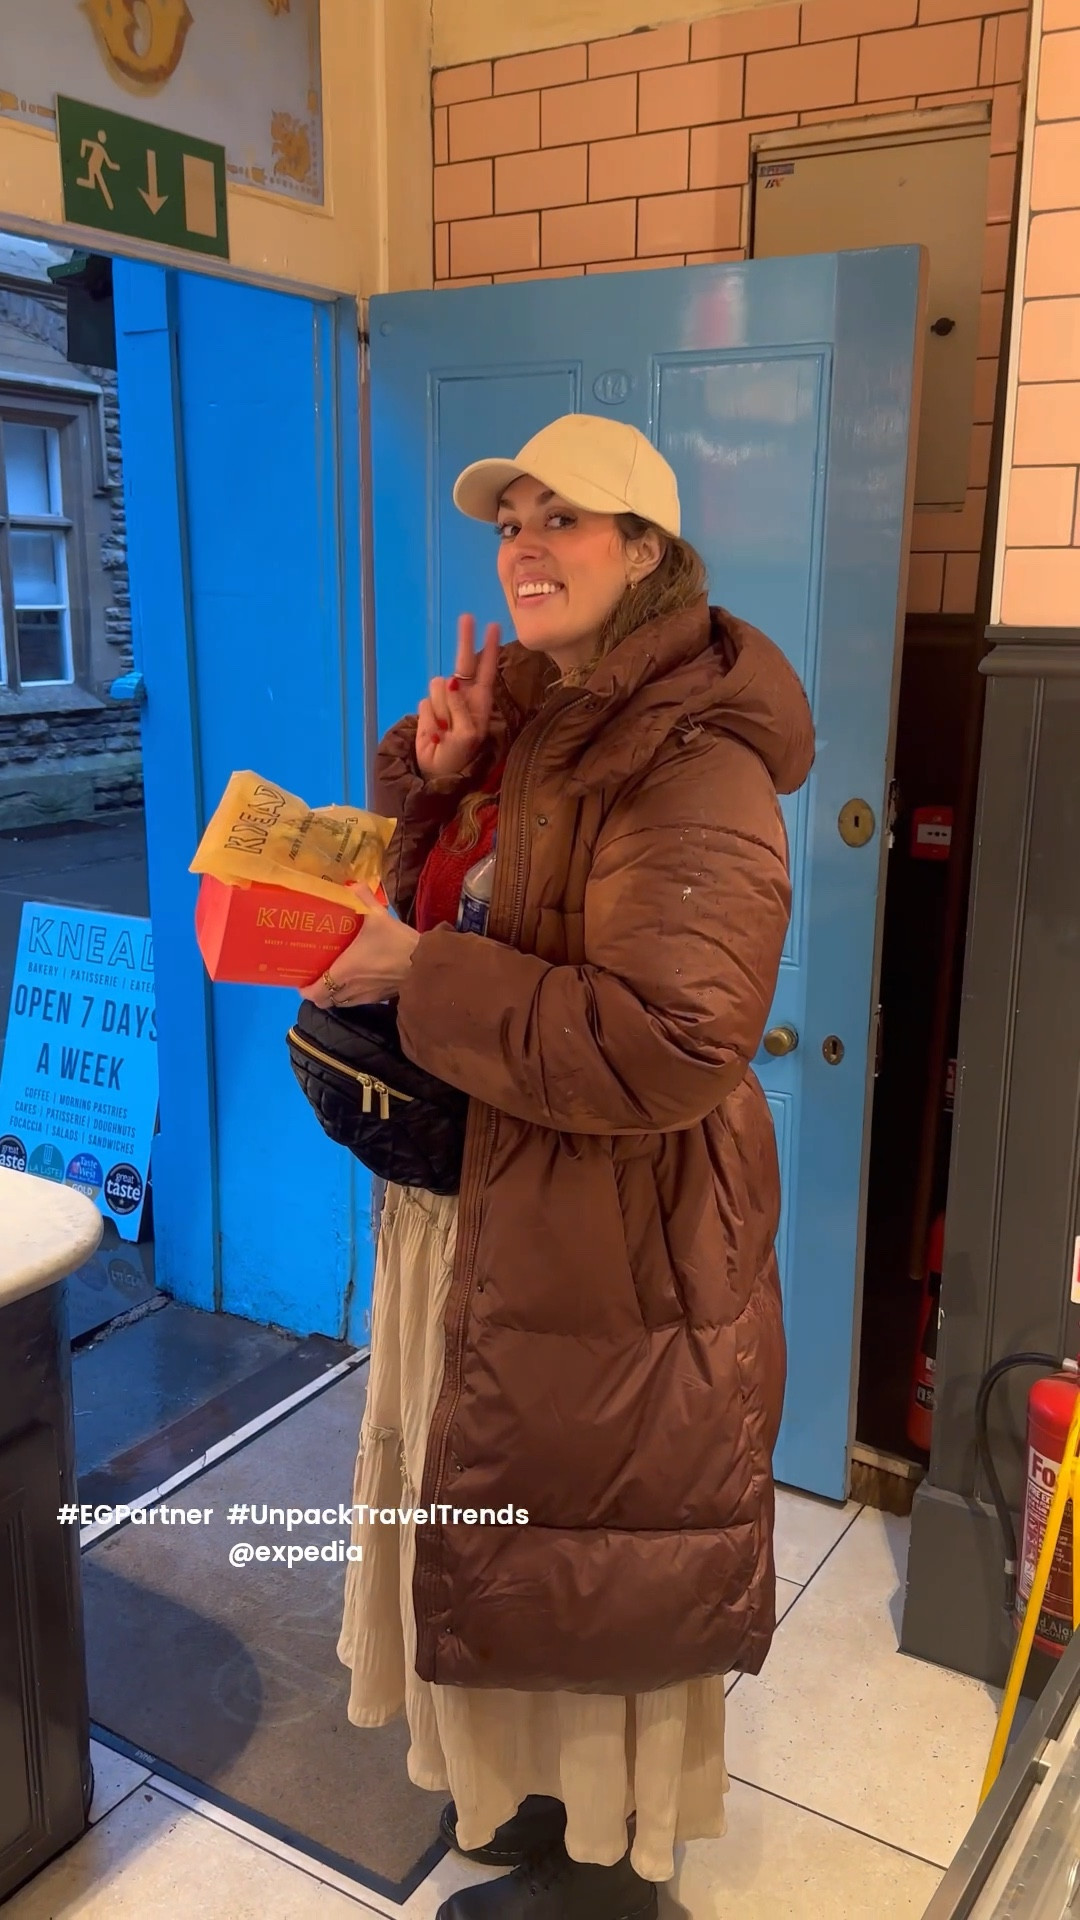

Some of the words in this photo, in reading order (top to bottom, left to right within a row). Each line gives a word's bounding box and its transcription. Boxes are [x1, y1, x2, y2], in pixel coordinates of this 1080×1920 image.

[256, 907, 357, 935] KNEAD
[28, 962, 59, 977] BAKERY
[70, 969, 118, 987] PATISSERIE
[130, 980, 155, 993] EATE
[14, 984, 72, 1025] OPEN
[81, 995, 95, 1028] 7
[102, 999, 157, 1041] DAYS
[36, 1042, 49, 1075] A
[60, 1046, 124, 1091] WEEK
[25, 1087, 50, 1101] COFFEE
[59, 1094, 91, 1111] MORNING
[92, 1102, 128, 1119] PASTRIES
[9, 1116, 42, 1132] FOCACCIA
[52, 1125, 78, 1141] SALADS
[88, 1134, 135, 1155] SANDWICHES
[15, 1101, 36, 1115] CAKES
[46, 1108, 87, 1127] PATISSERIE
[93, 1118, 136, 1139] DOUGHNUTS
[0, 1154, 25, 1171] aste
[80, 1156, 98, 1169] Taste
[107, 1178, 140, 1201] taste
[115, 1173, 134, 1185] great
